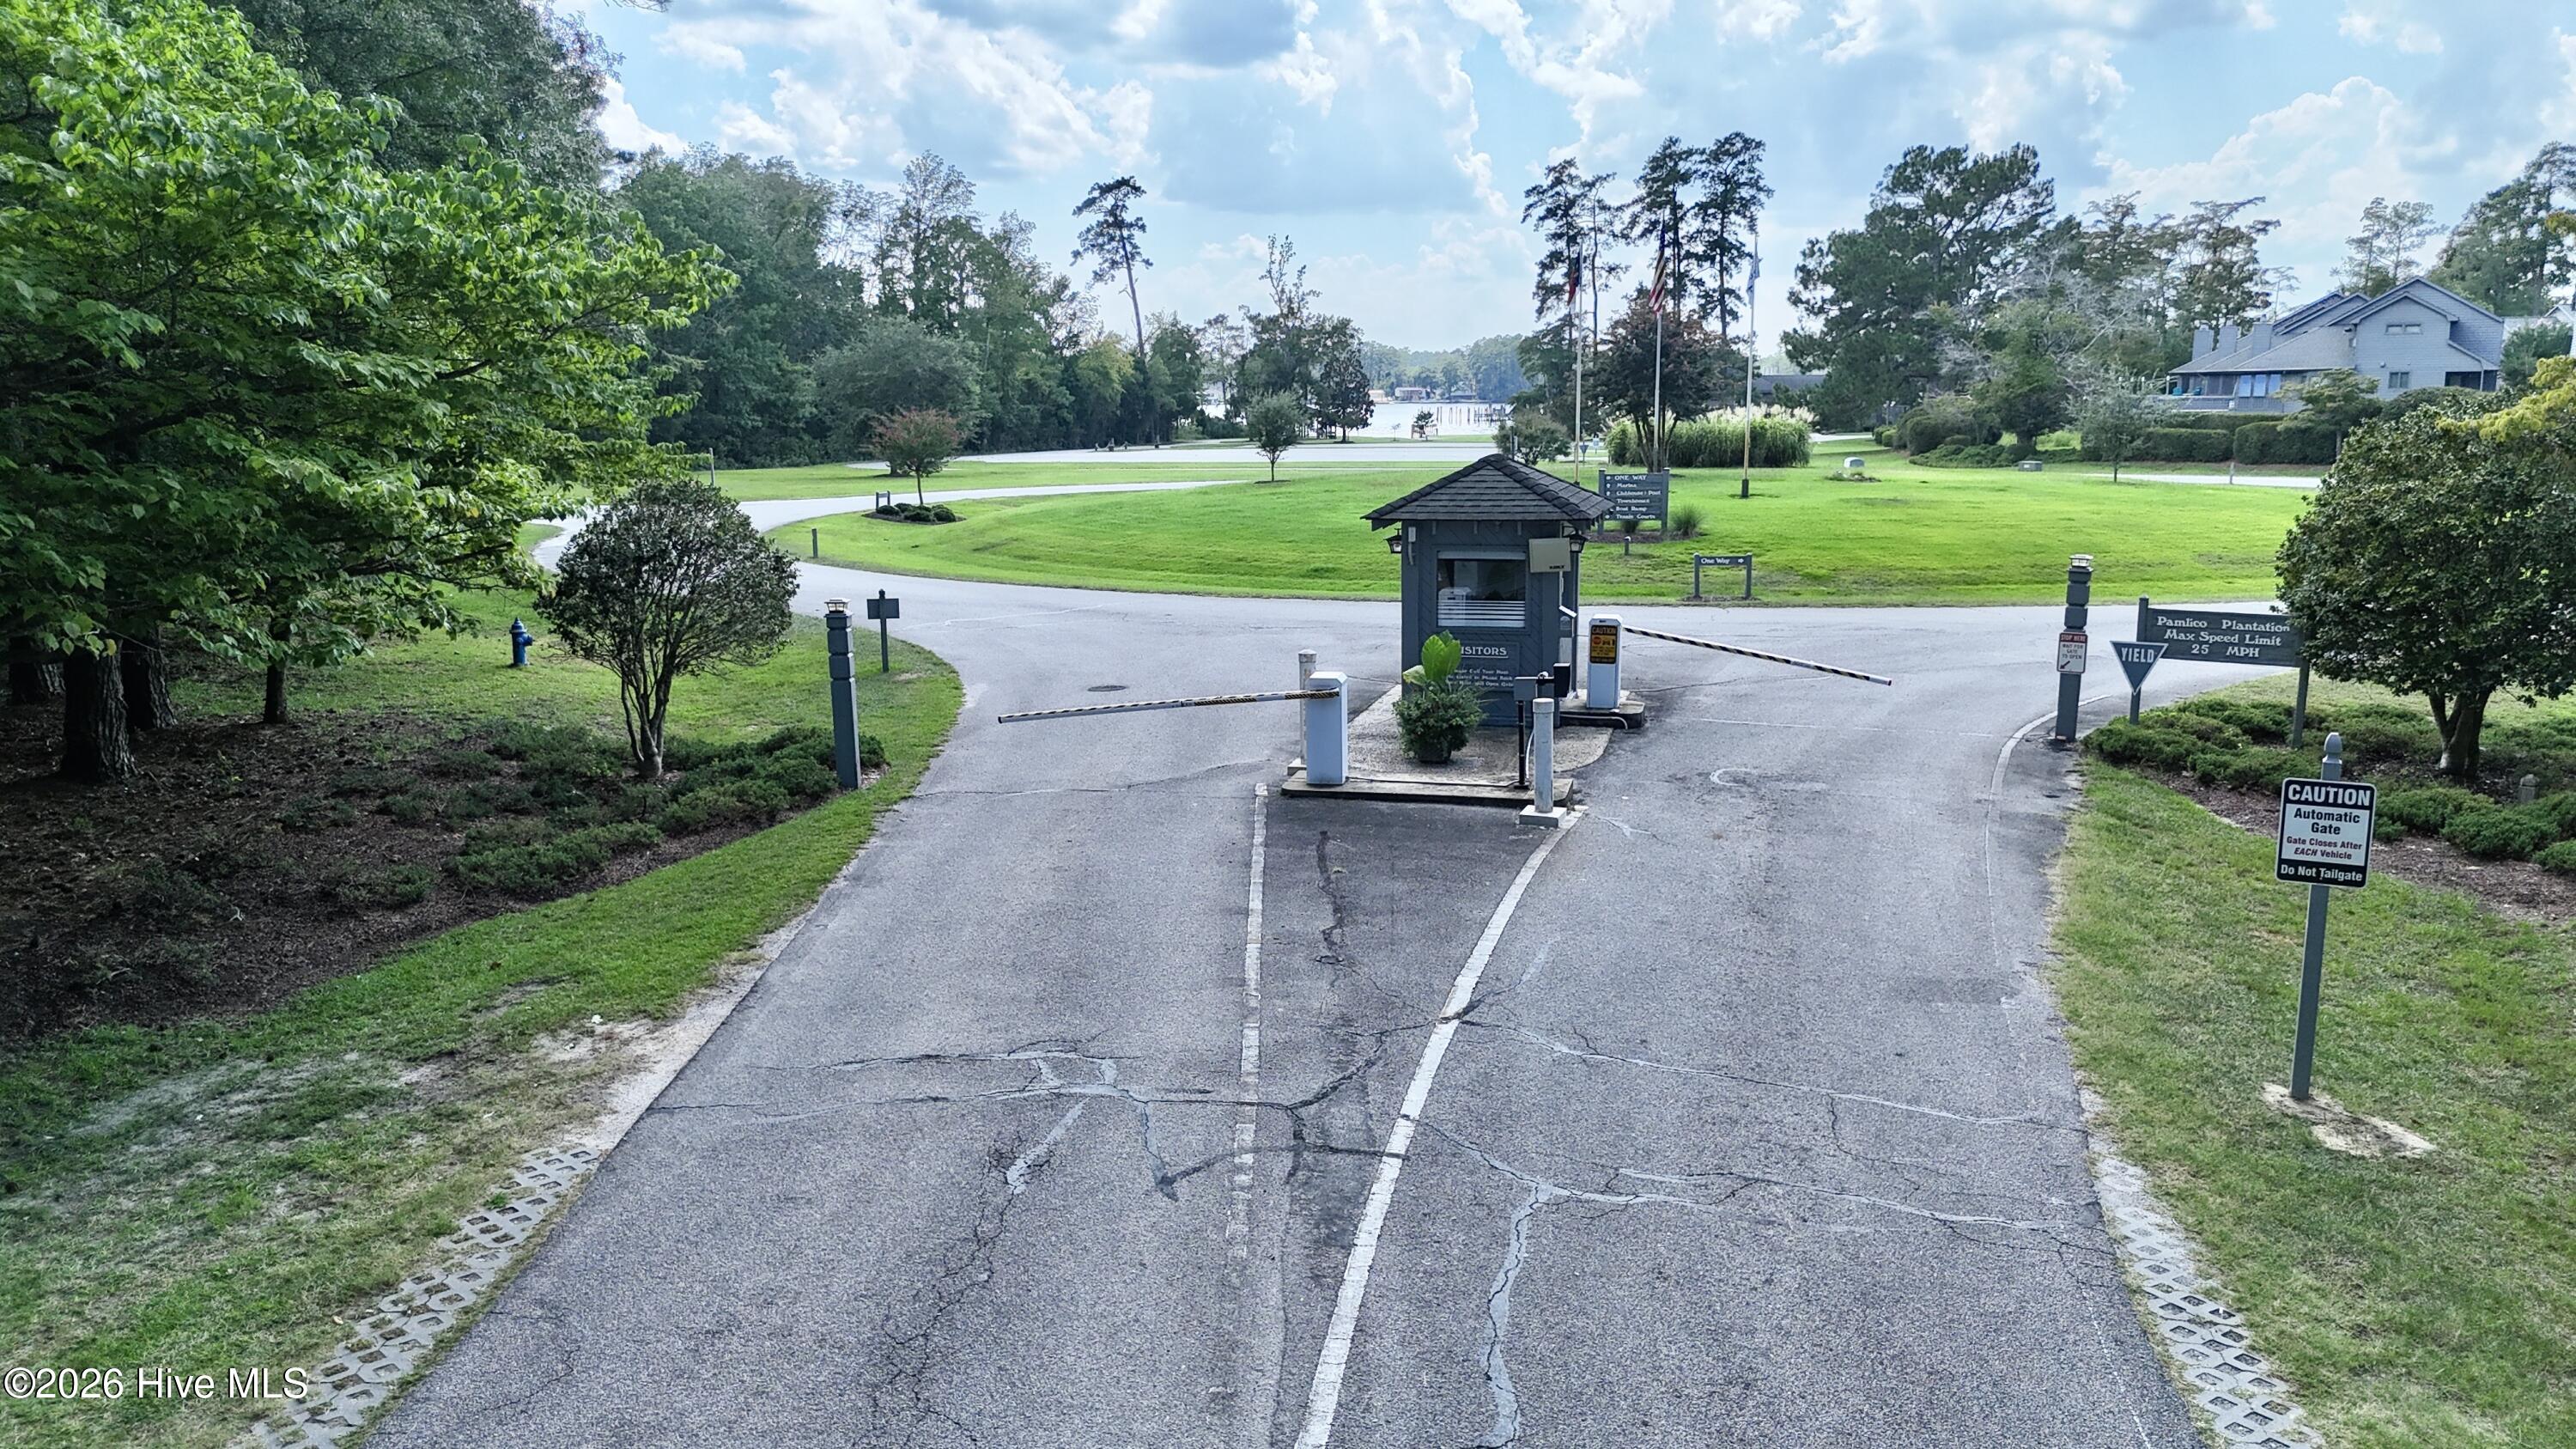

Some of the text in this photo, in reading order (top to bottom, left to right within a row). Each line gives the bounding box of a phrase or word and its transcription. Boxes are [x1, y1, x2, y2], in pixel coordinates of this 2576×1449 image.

[2156, 616, 2291, 633] Pamlico Plantation
[2164, 630, 2281, 647] Max Speed Limit
[1461, 646, 1507, 655] ISITORS
[2121, 647, 2154, 663] YIELD
[2190, 644, 2260, 658] 25 MPH
[2287, 784, 2371, 807] CAUTION
[2293, 807, 2360, 824] Automatic
[2311, 822, 2341, 835] Gate
[2287, 836, 2363, 850] Gate Closes After
[2293, 847, 2352, 860] EACH Vehicle
[2281, 864, 2363, 881] Do Not Tailgate
